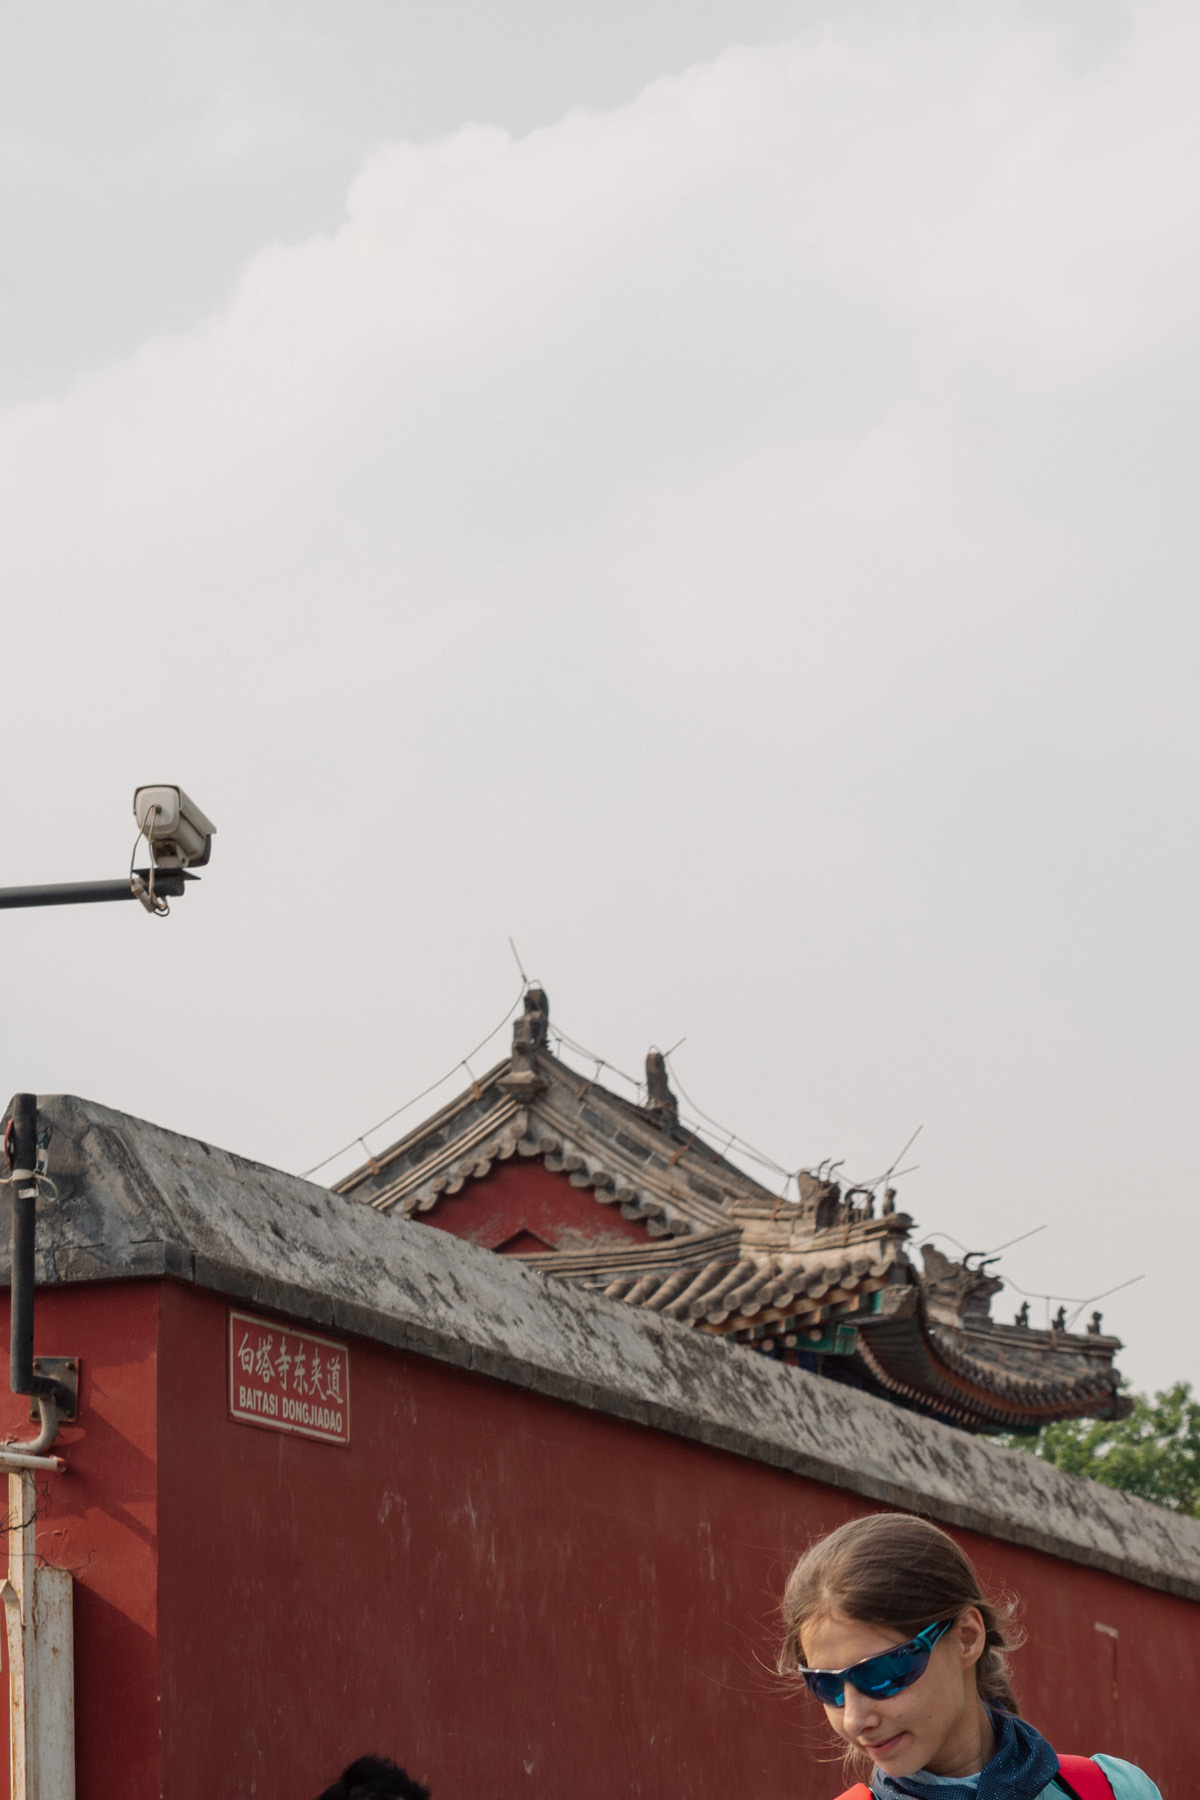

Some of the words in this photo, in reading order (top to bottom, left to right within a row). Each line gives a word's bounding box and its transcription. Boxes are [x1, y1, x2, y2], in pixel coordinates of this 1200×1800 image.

[237, 1332, 344, 1404] 白塔寺东夹道
[239, 1385, 279, 1416] BAITASI
[282, 1397, 343, 1433] DONGJIADAO
